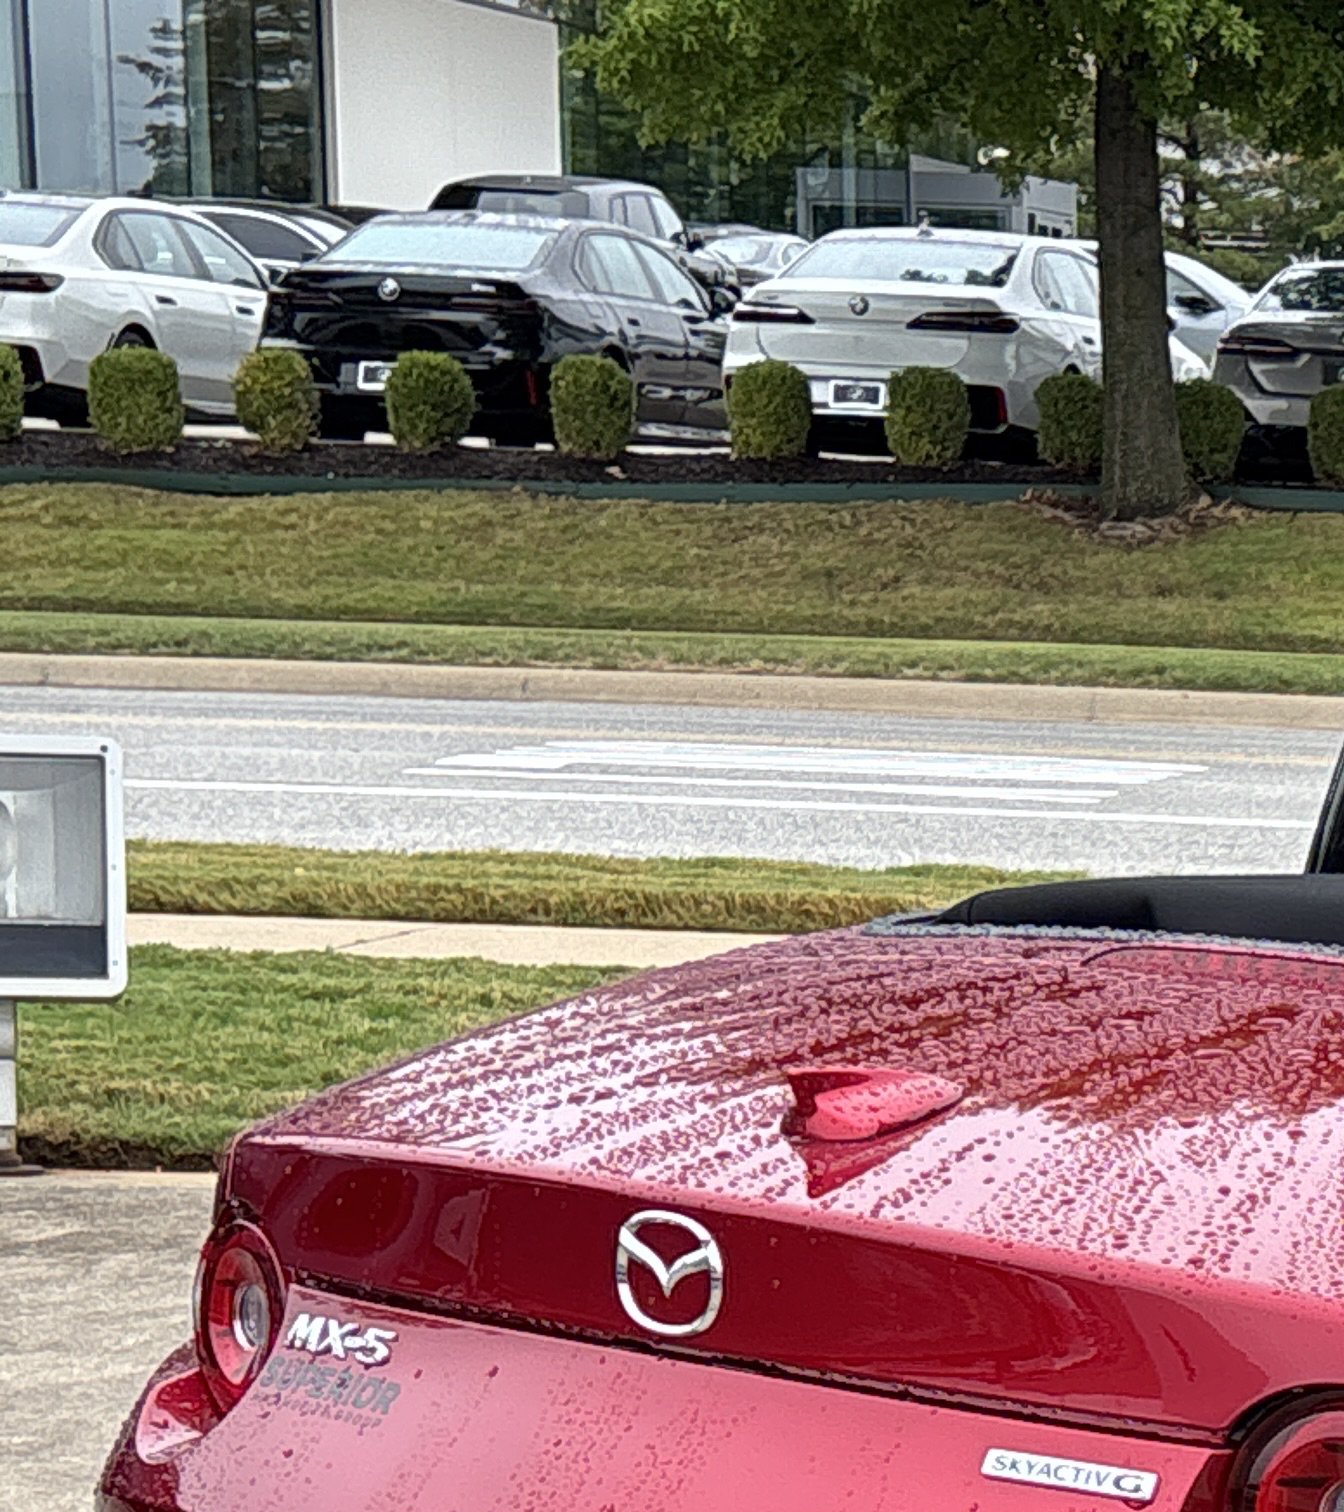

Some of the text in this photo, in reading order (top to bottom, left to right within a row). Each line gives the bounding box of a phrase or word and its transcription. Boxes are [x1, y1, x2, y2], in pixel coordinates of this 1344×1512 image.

[284, 1313, 398, 1366] MX-5
[259, 1355, 401, 1415] SUPERIOR
[992, 1455, 1146, 1499] SKYACTIV G
